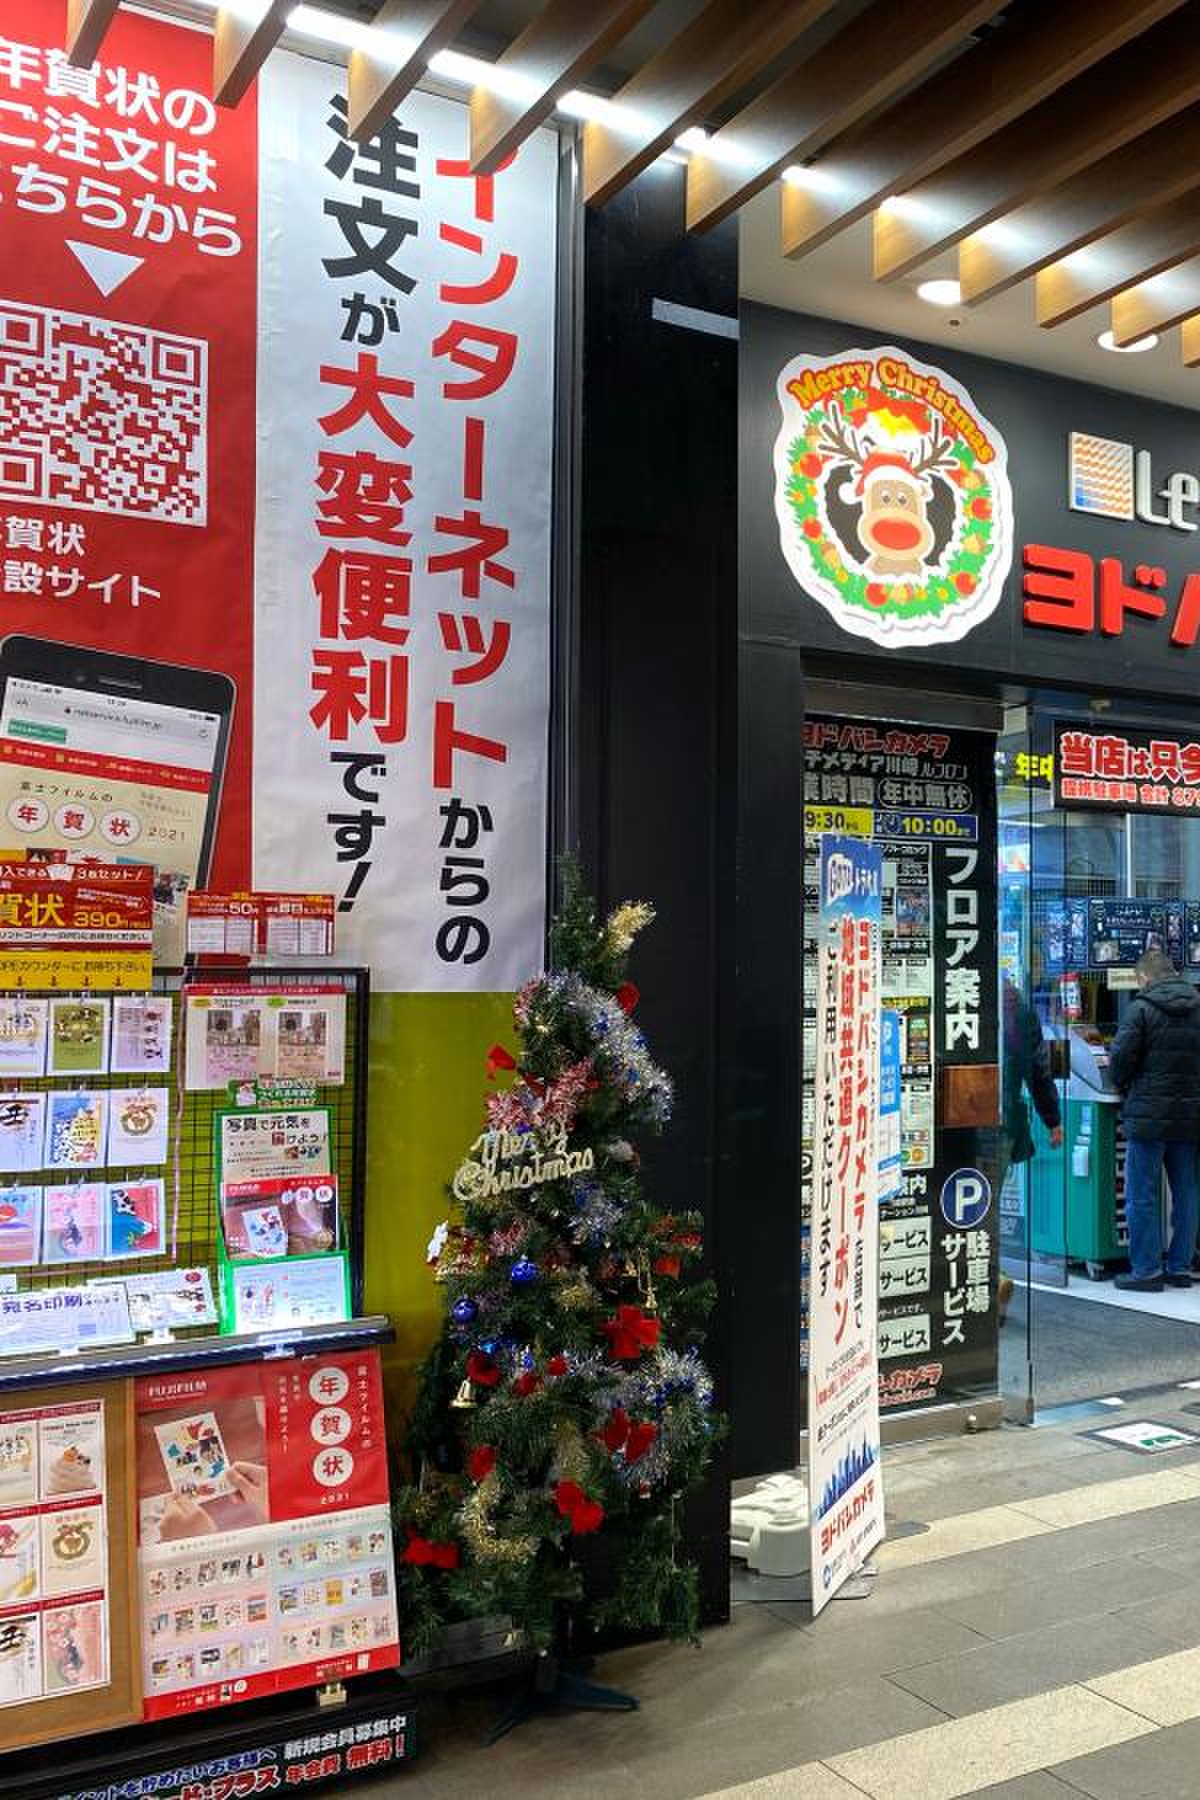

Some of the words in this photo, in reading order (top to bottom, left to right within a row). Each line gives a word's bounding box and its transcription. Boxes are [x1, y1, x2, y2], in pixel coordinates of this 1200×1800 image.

[0, 36, 217, 136] 年賀状の
[0, 98, 217, 193] ご注文は
[0, 162, 242, 257] ちらから
[787, 361, 873, 410] Merry
[876, 356, 995, 464] Christmas
[0, 515, 85, 557] 賀状
[0, 560, 161, 607] 設サイト
[427, 144, 520, 966] インターネットからの
[945, 847, 980, 1051] フロア案内
[452, 1147, 594, 1201] Christmas
[954, 1177, 983, 1222] P
[881, 1267, 928, 1290] サービス
[940, 1233, 966, 1345] サービス
[965, 1229, 991, 1313] 駐車場
[880, 1329, 929, 1352] サービス
[319, 1375, 344, 1477] 年賀状
